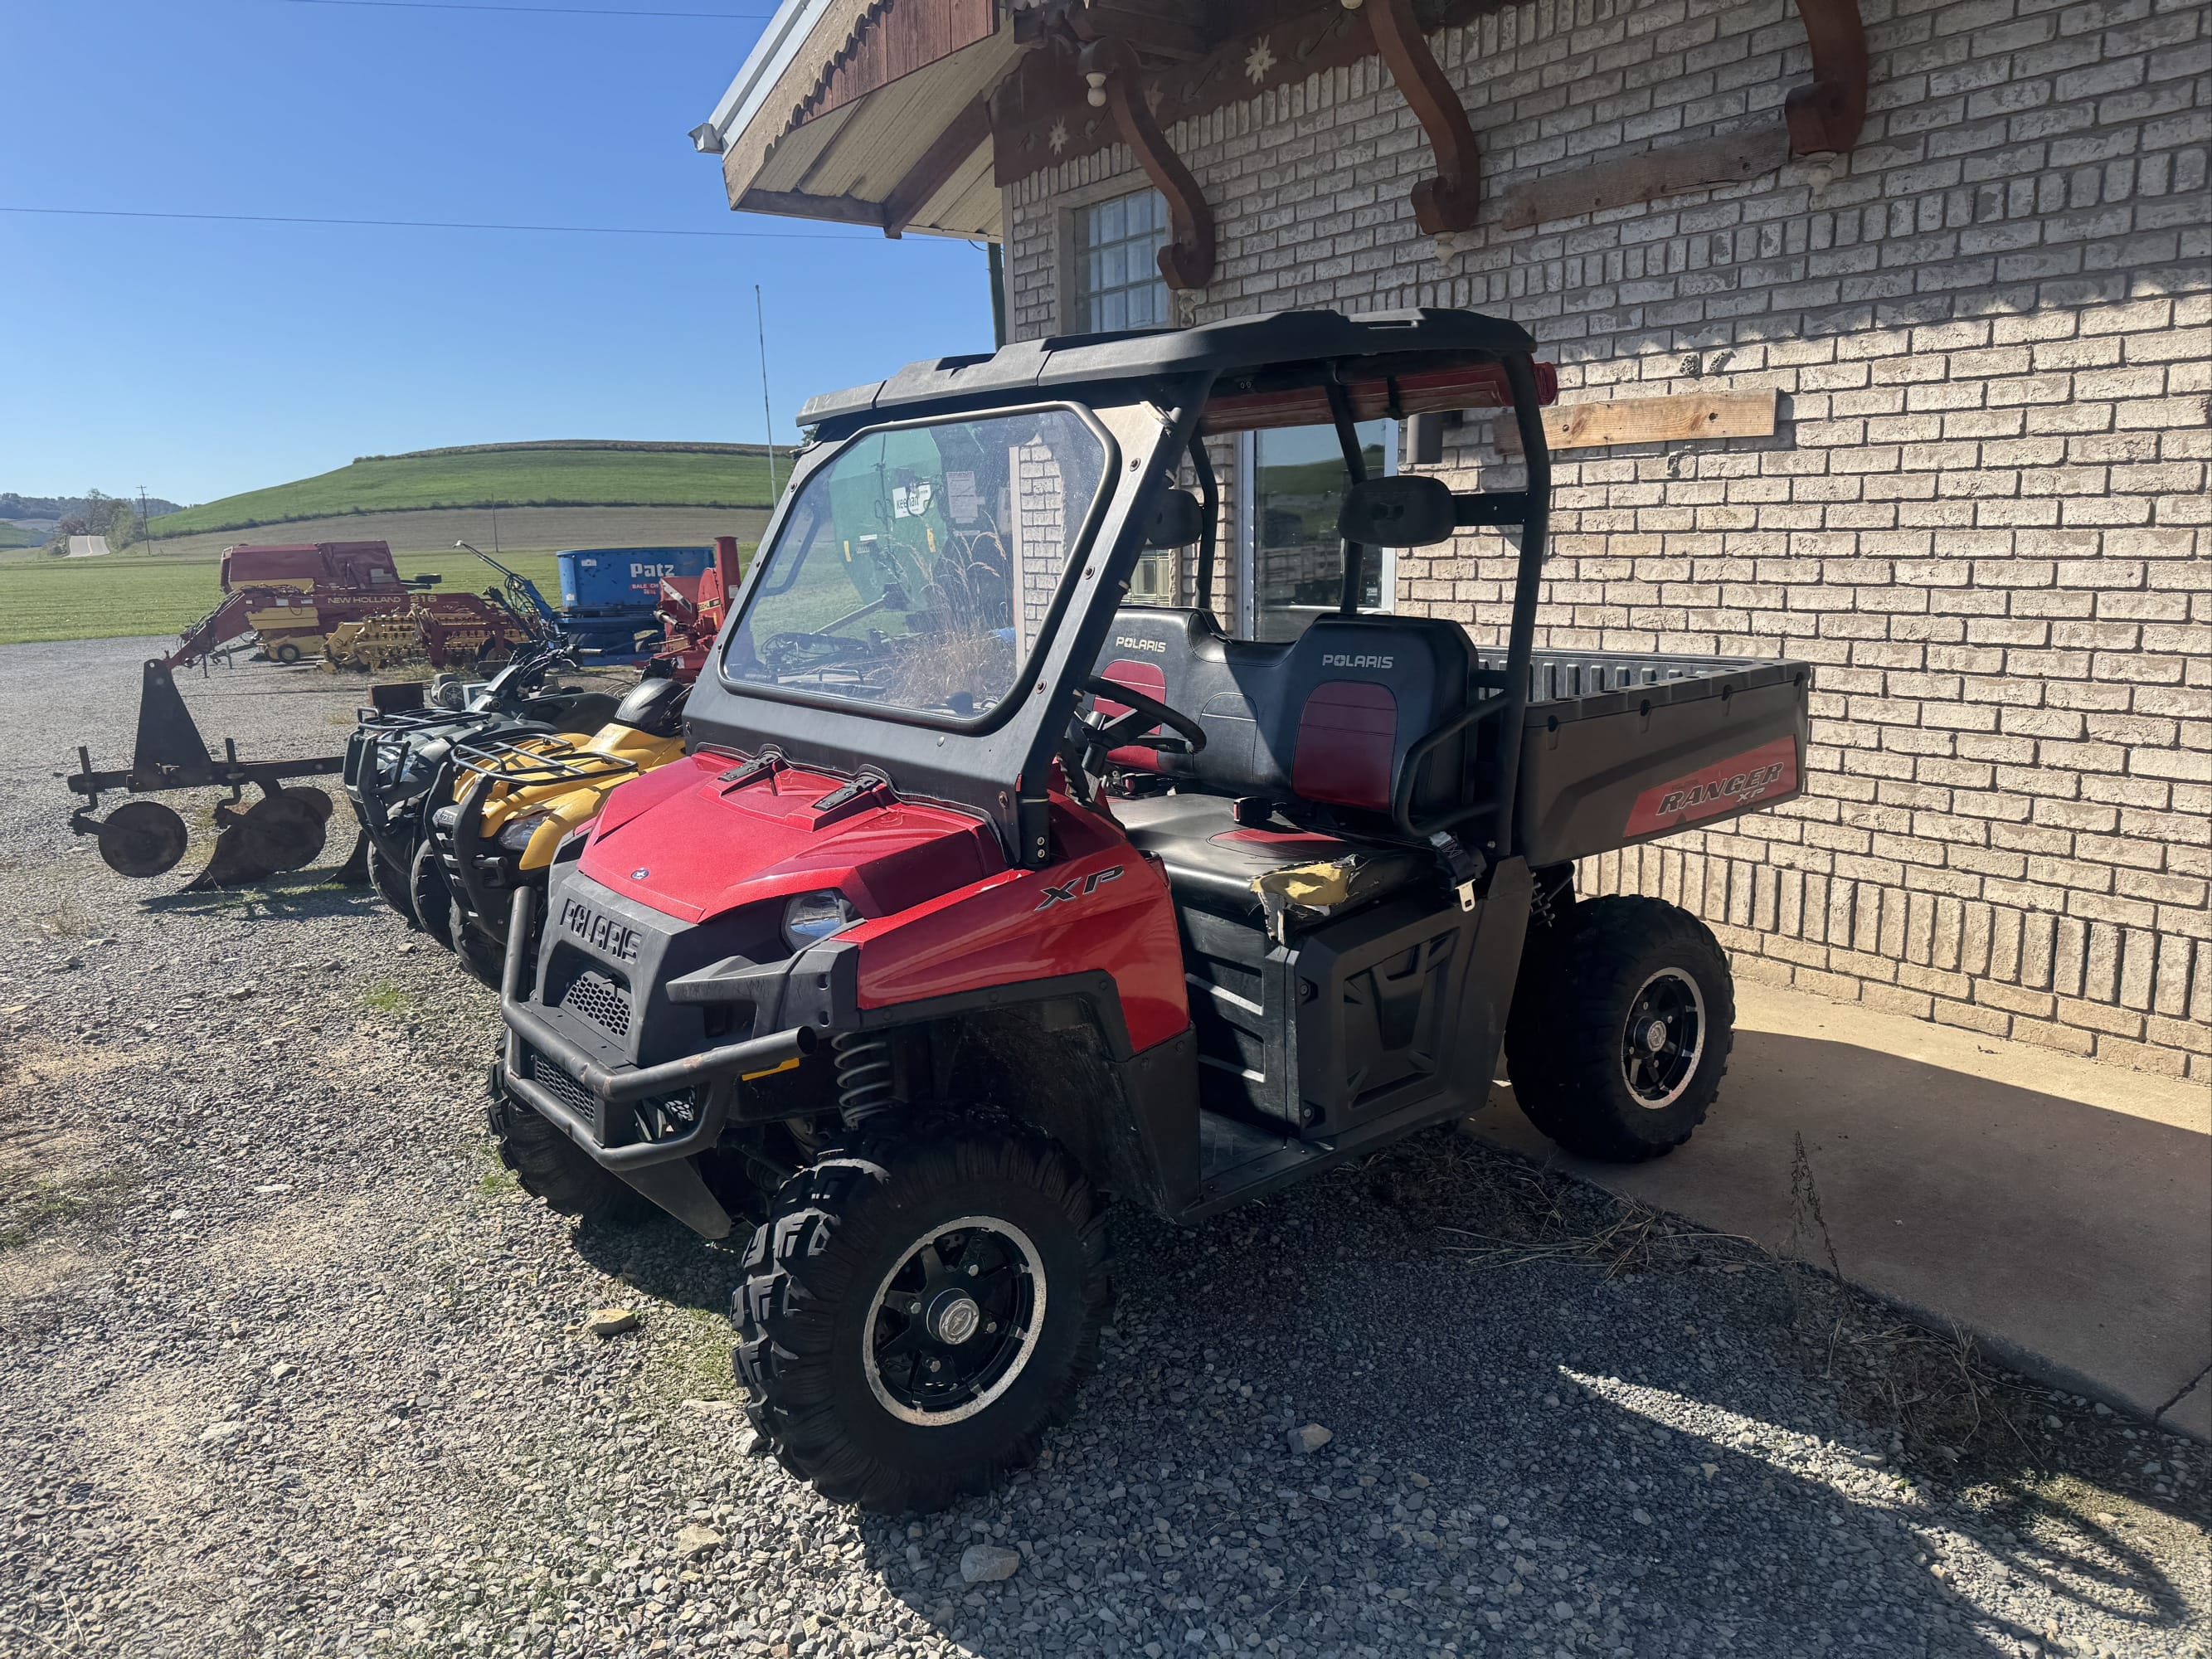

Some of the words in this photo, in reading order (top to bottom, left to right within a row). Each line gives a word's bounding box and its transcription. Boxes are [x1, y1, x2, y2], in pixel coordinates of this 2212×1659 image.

[630, 563, 675, 578] Patz
[1116, 636, 1167, 653] POLARIS
[1322, 654, 1394, 669] POLARIS
[1655, 762, 1784, 815] RANGER
[1736, 787, 1765, 803] XP
[1033, 864, 1125, 912] XP
[559, 898, 643, 965] POLARIS
